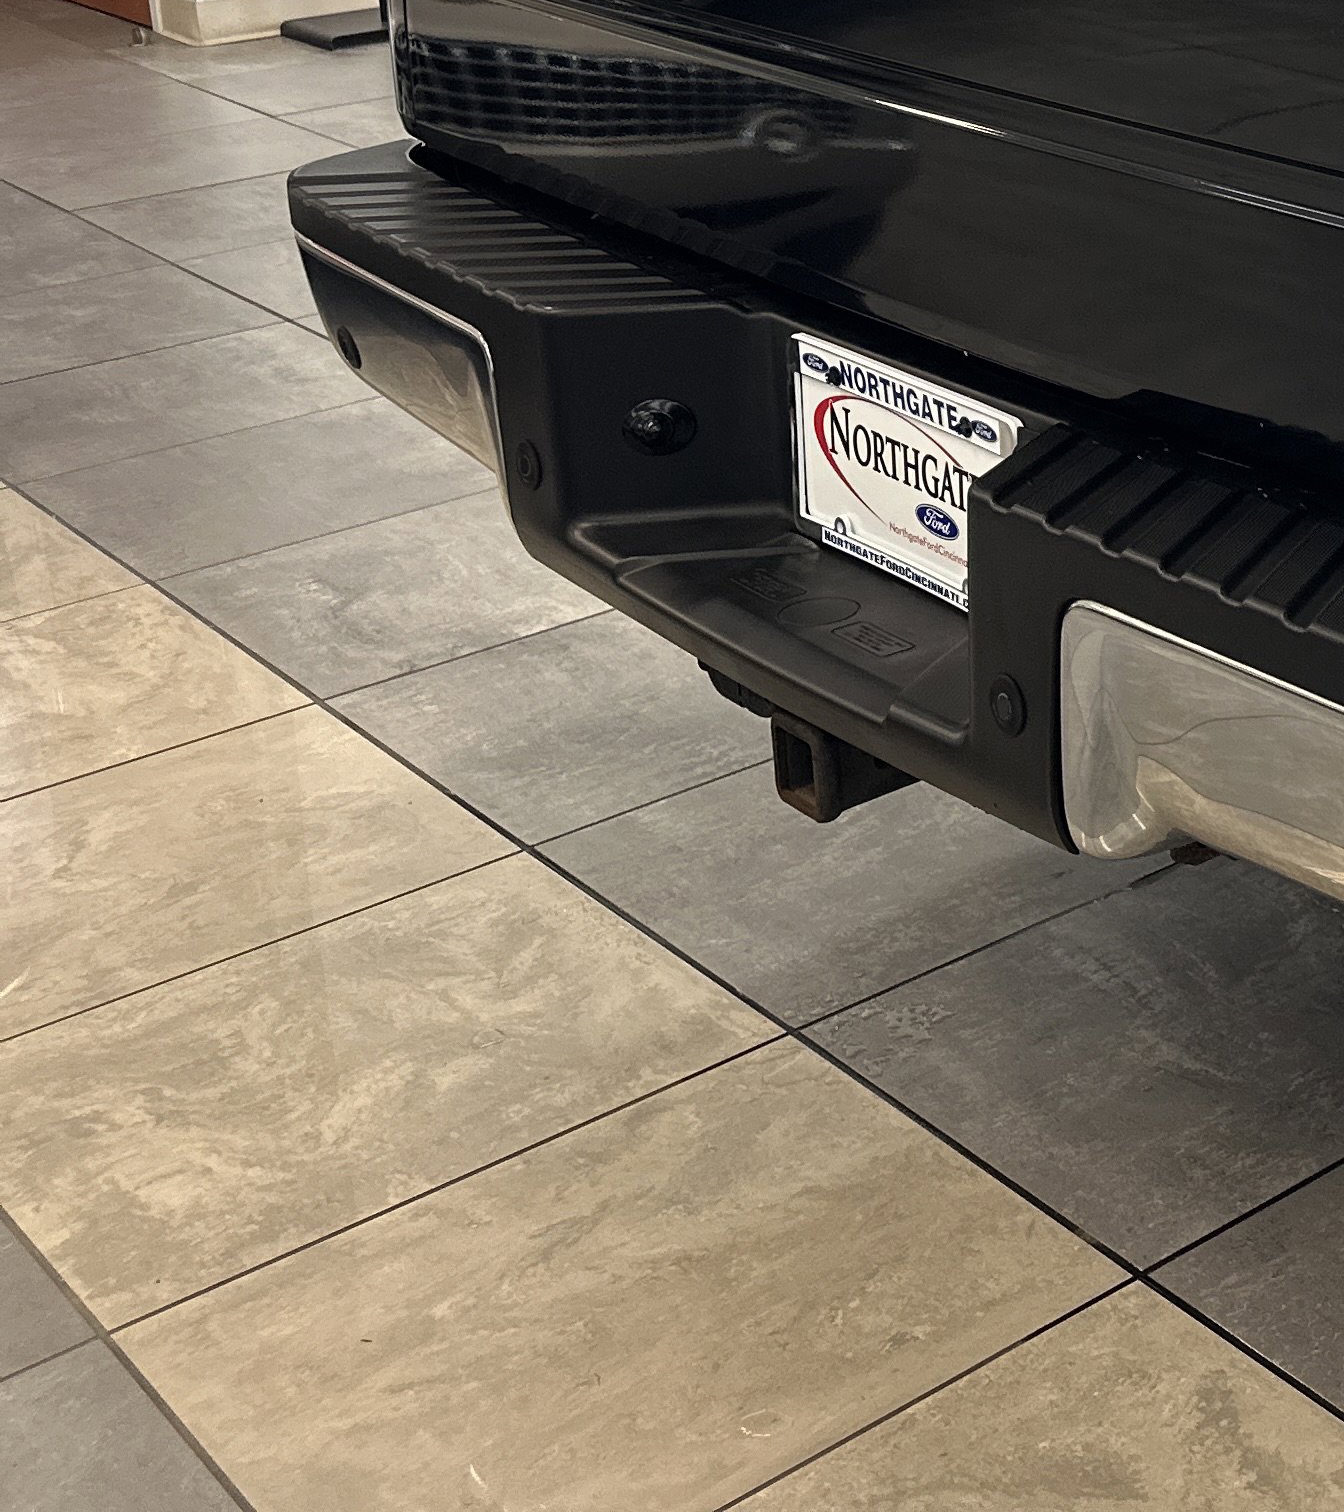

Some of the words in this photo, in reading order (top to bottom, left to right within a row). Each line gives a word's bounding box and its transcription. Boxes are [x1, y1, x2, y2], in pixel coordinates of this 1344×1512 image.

[805, 354, 825, 371] Ford
[840, 360, 960, 428] NORTHGATE
[973, 423, 993, 440] Ford
[829, 400, 977, 511] NORTHGAT
[921, 506, 954, 537] Ford
